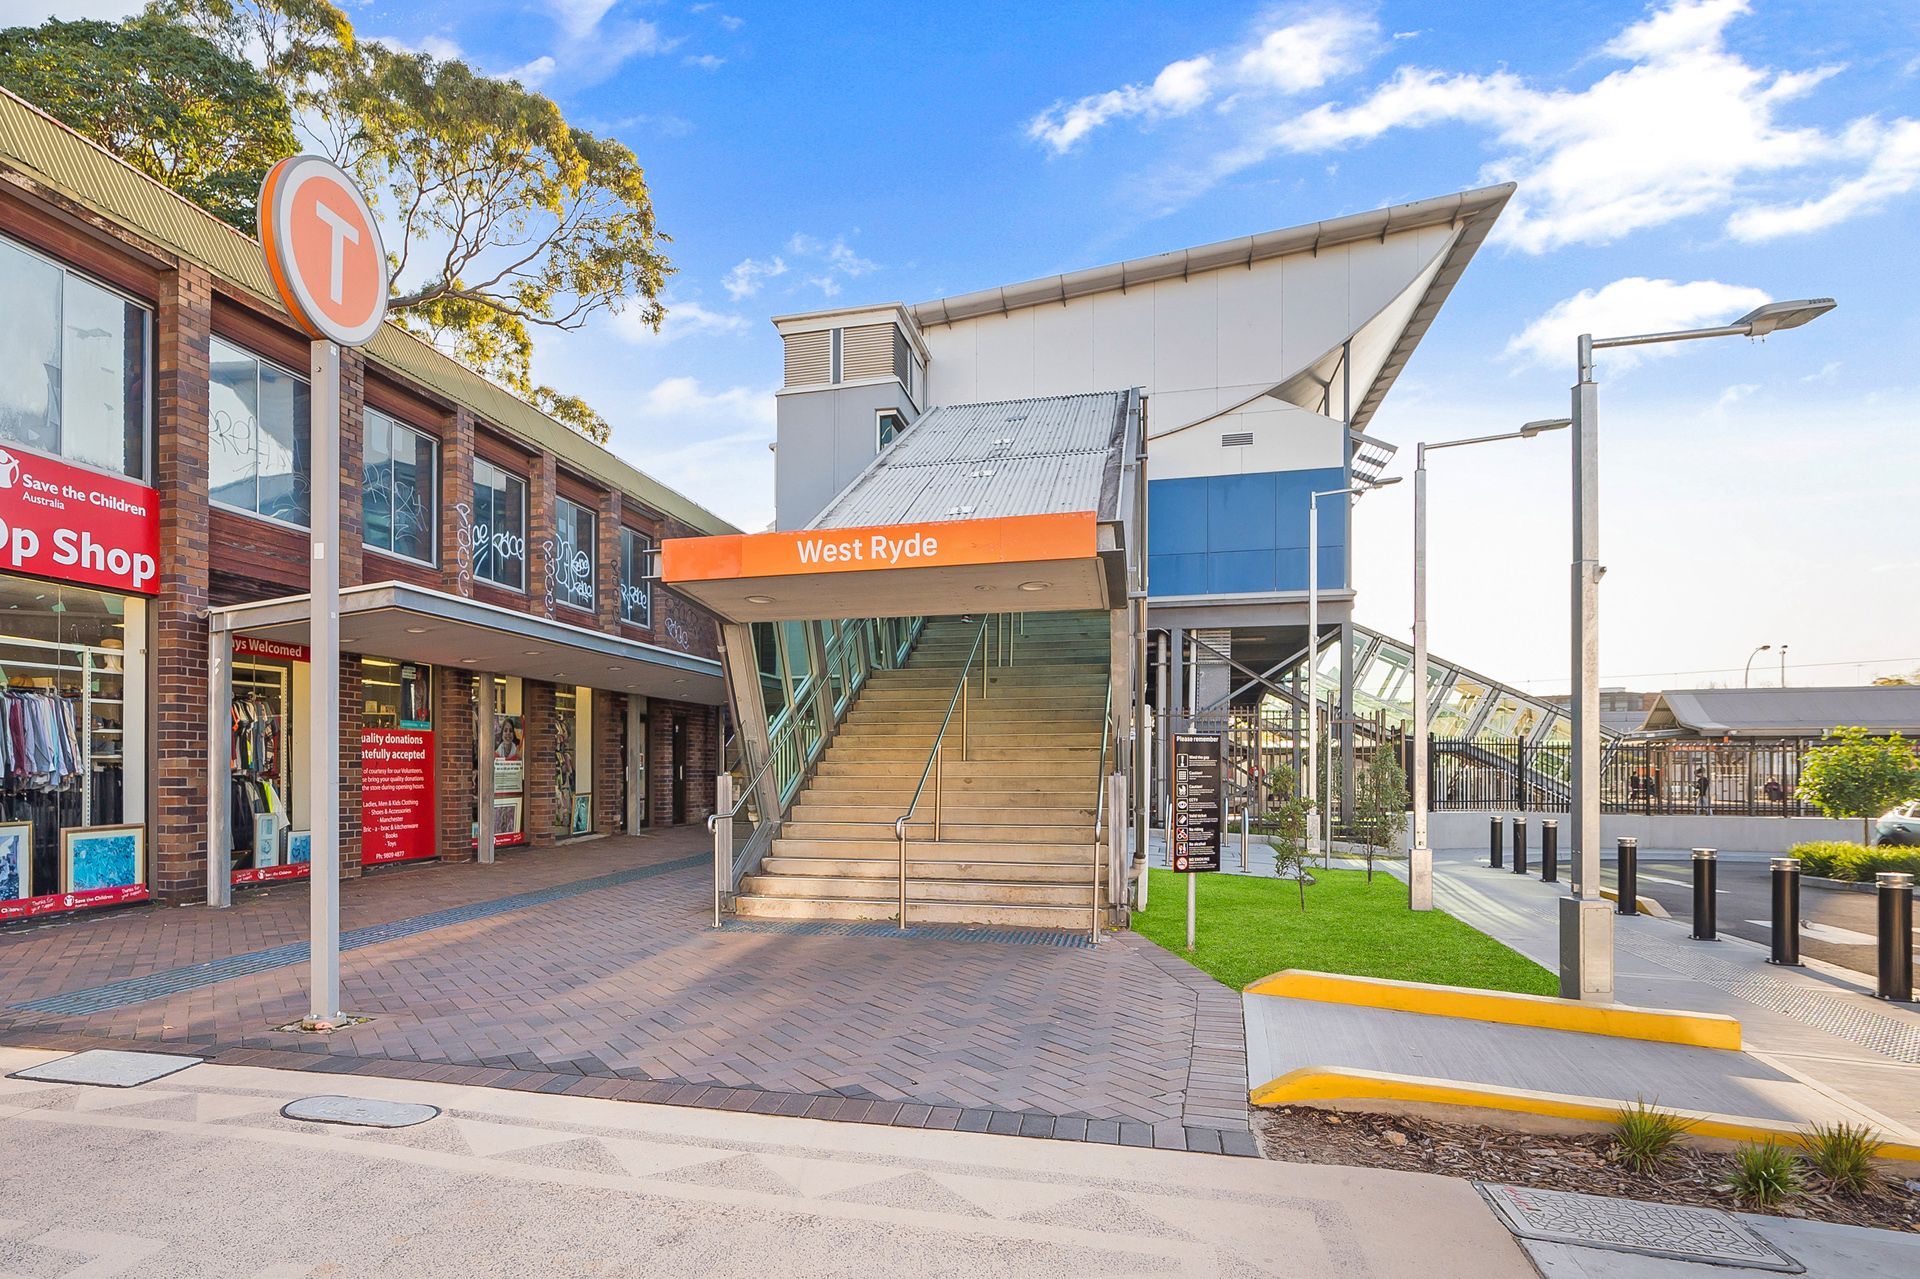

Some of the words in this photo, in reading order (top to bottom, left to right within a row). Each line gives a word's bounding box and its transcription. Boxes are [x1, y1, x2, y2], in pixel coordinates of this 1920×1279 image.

[316, 199, 360, 305] T
[22, 474, 58, 494] Save
[62, 485, 86, 502] the
[89, 491, 146, 517] Children
[22, 492, 65, 510] Australia
[52, 528, 156, 588] Shop
[797, 539, 863, 564] West
[871, 533, 938, 564] Ryde
[248, 638, 302, 658] Welcomed
[361, 732, 384, 746] uality
[385, 733, 423, 745] donations
[361, 748, 390, 762] atefully
[391, 749, 425, 761] accepted
